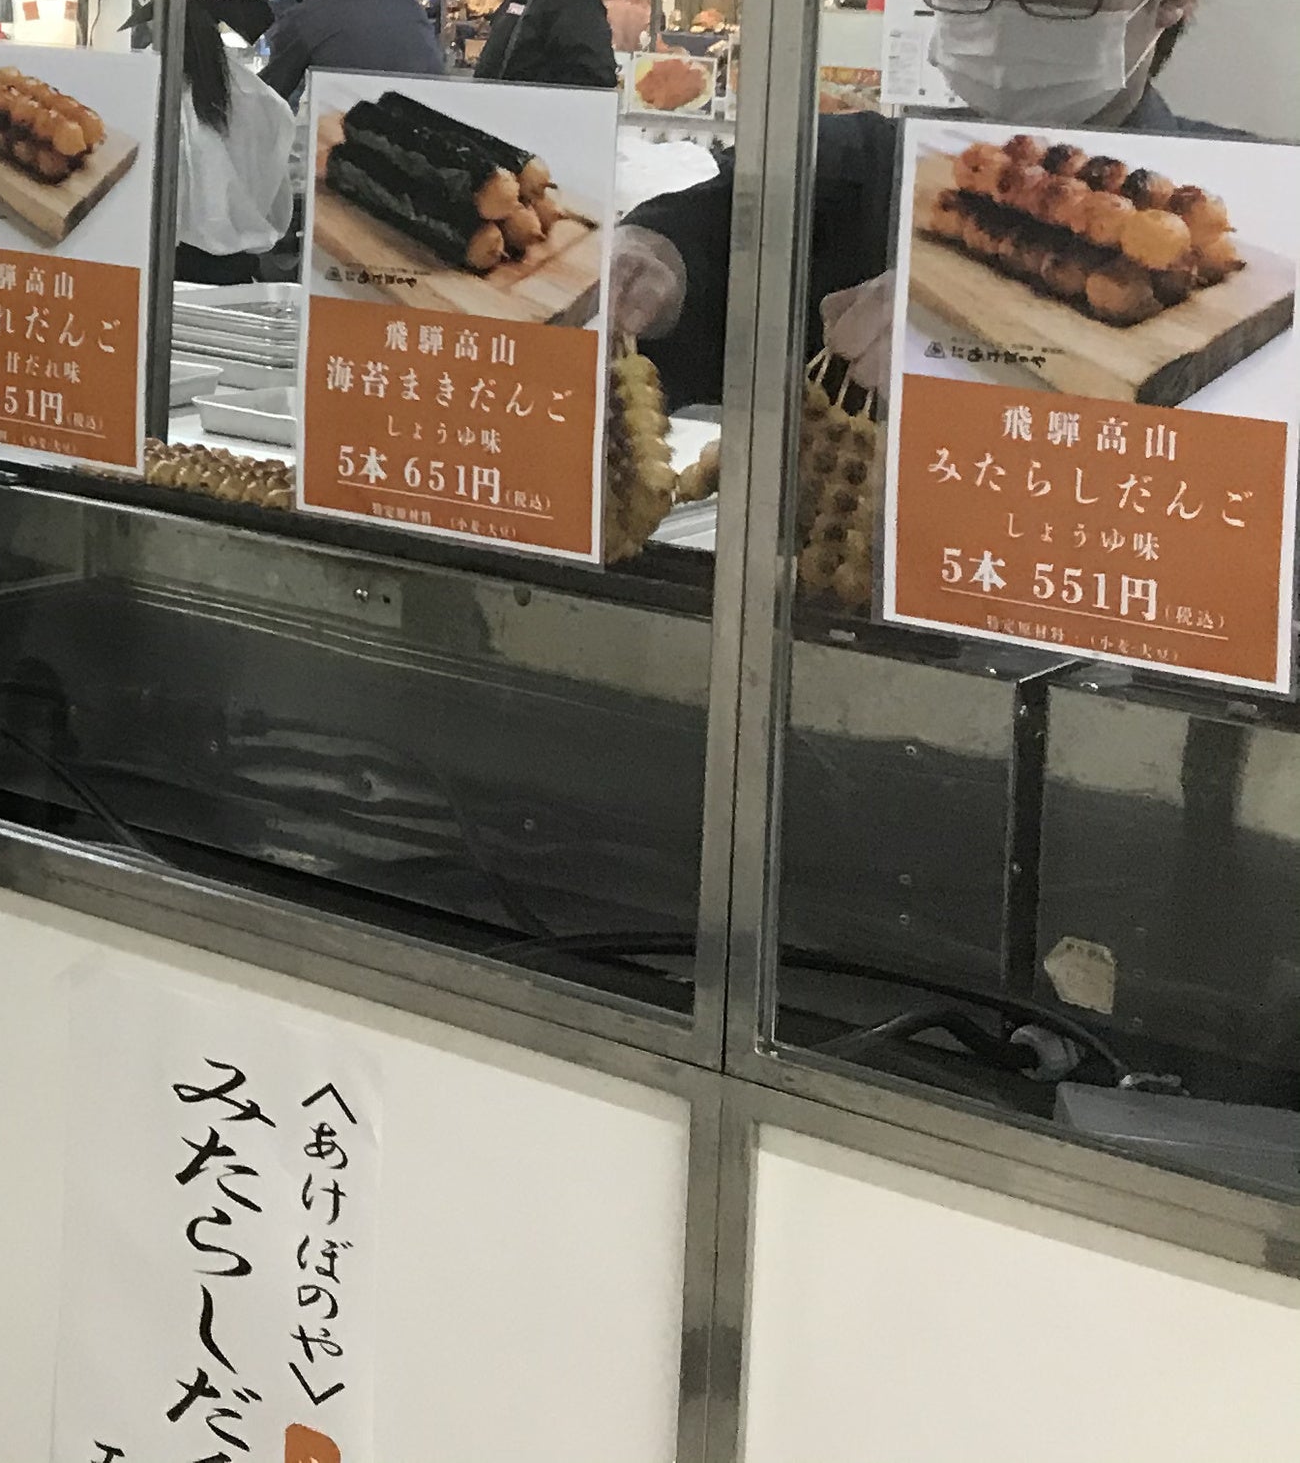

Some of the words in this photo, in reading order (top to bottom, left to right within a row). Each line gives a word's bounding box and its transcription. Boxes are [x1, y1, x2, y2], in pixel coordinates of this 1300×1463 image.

[5, 351, 81, 384] 甘だれ味
[384, 321, 516, 366] 飛騨高山
[327, 356, 573, 422] 海苔まきだんご
[387, 415, 501, 454] しょうゆ味
[1002, 406, 1177, 461] 飛騨高山
[338, 446, 388, 484] 5本
[404, 457, 500, 505] 651円
[928, 447, 1253, 528] みたらしだんご
[1007, 512, 1160, 562] しょうゆ味
[941, 548, 1006, 592] 5本
[1033, 563, 1157, 621] 551円
[166, 1057, 277, 1463] みたらしだ
